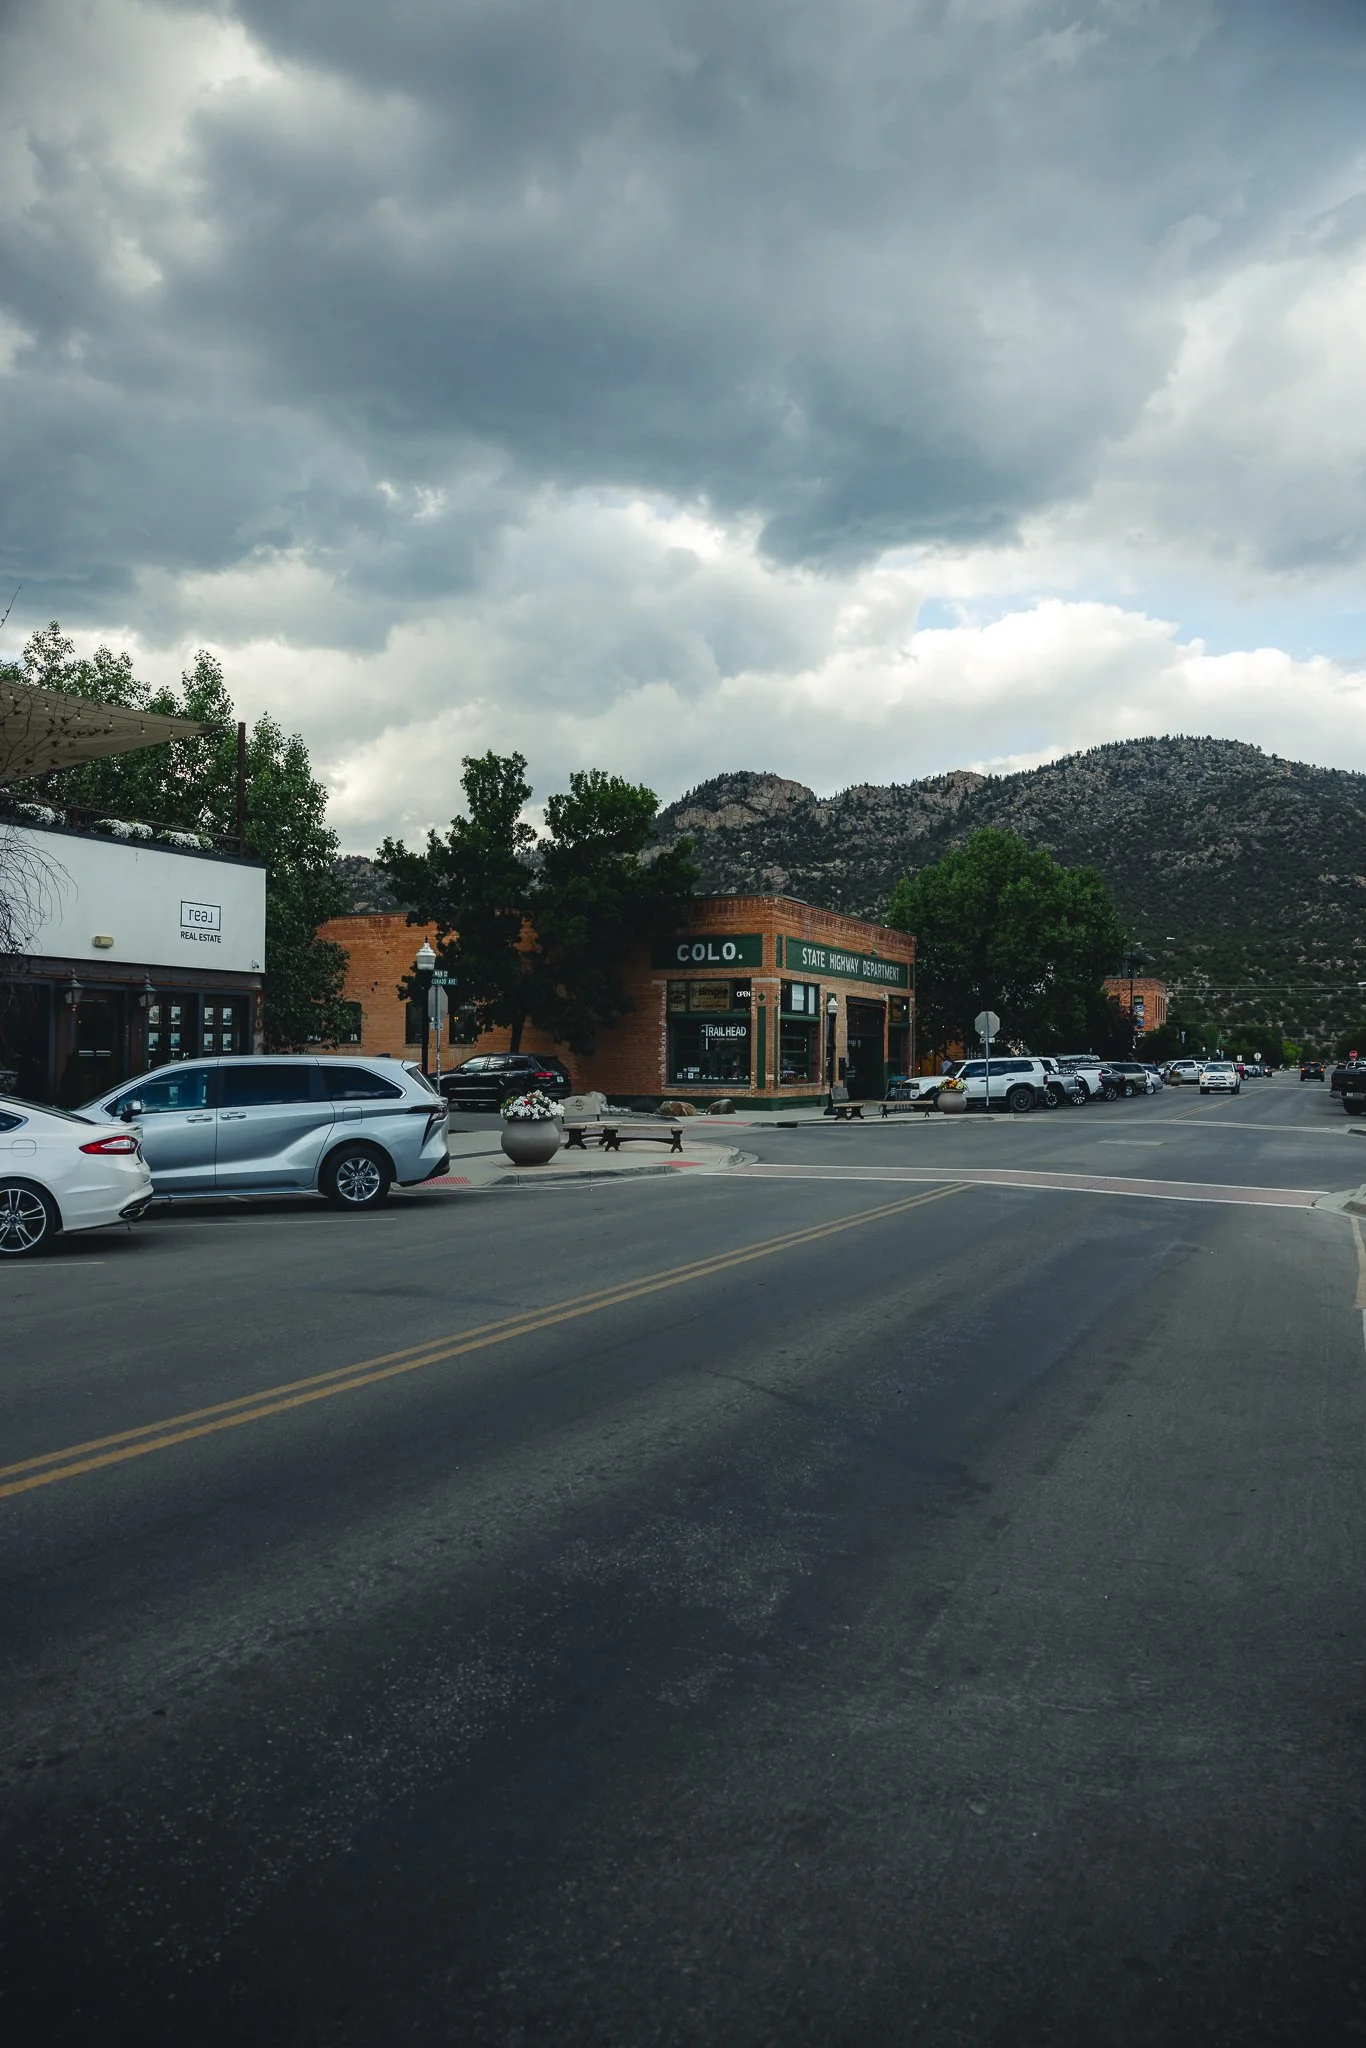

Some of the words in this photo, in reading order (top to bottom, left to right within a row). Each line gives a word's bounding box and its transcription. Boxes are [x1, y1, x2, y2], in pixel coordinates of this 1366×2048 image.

[181, 931, 197, 941] REAL
[199, 933, 221, 944] ESTATE
[677, 942, 743, 961] COLO.
[802, 947, 825, 968] STATE
[829, 953, 859, 974] HIGHWAY
[862, 960, 900, 982] DEPARTMENT
[736, 990, 751, 998] OPEN
